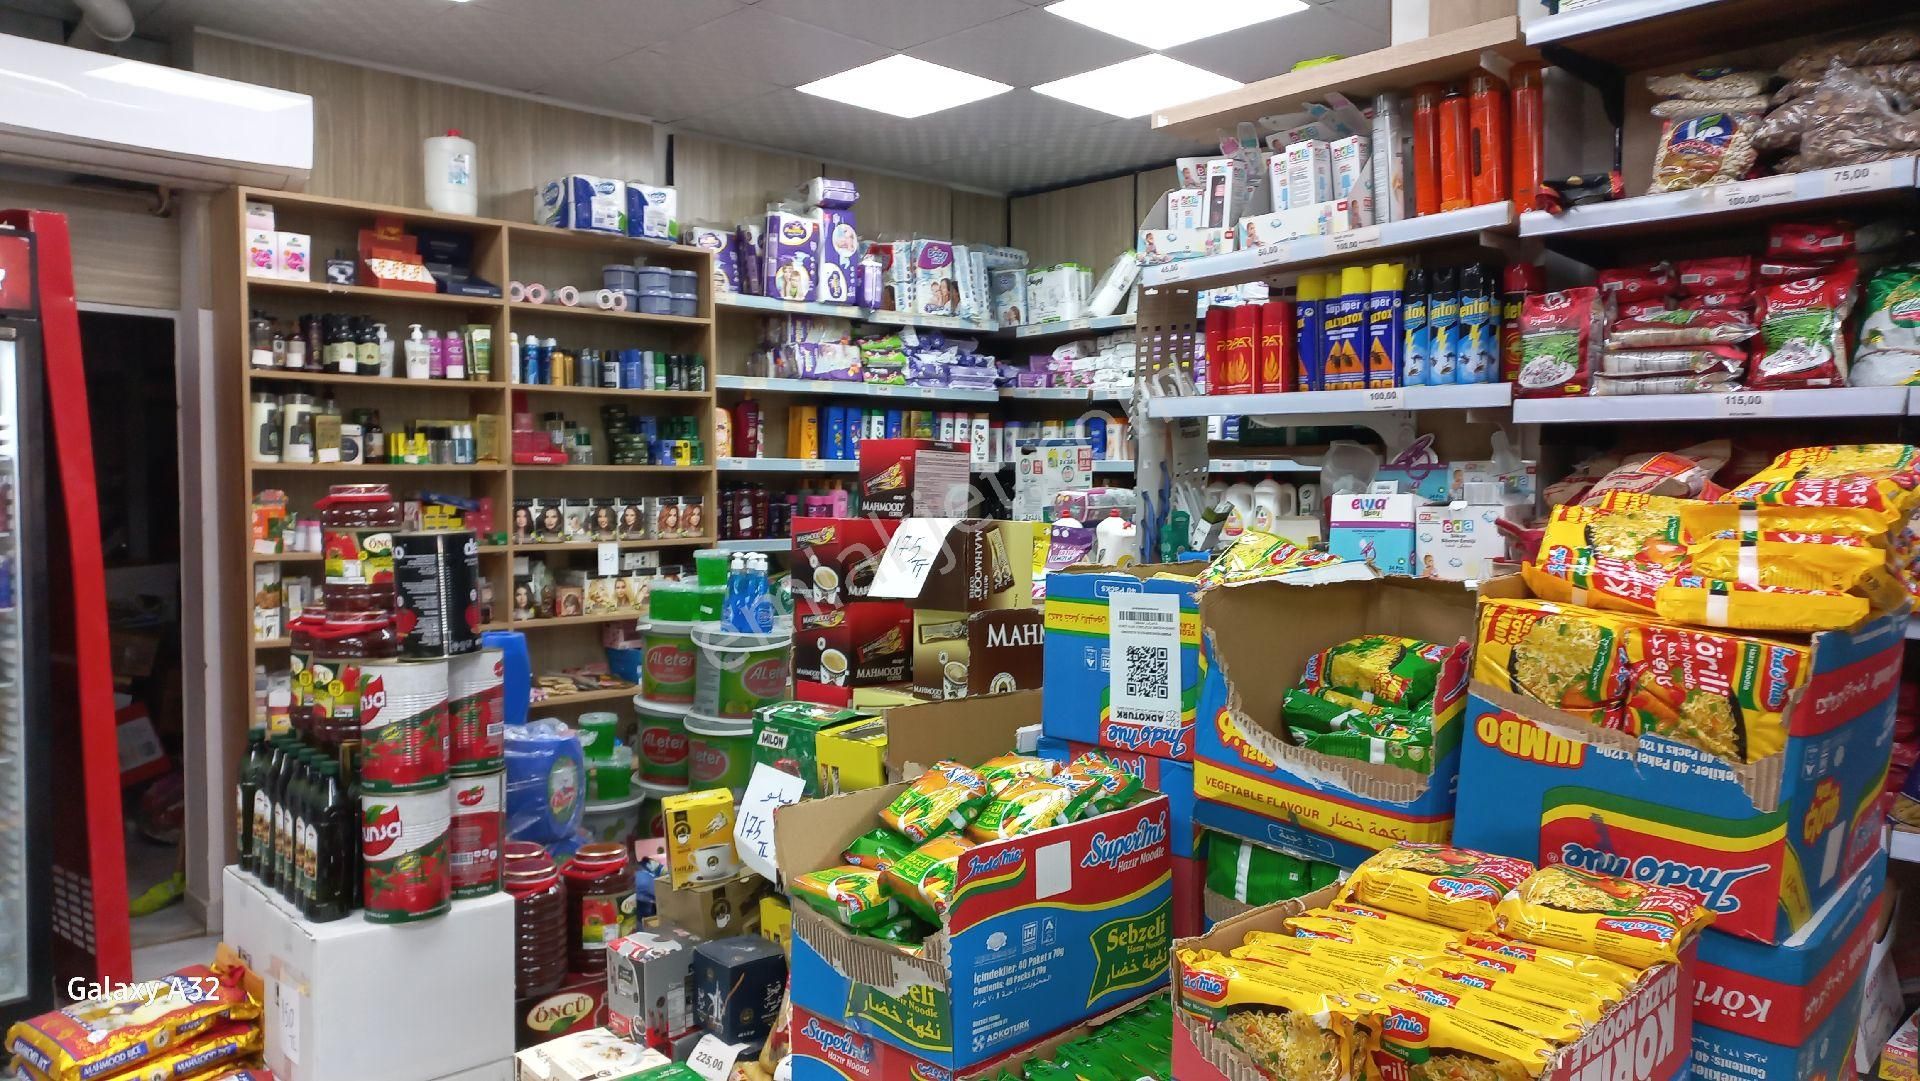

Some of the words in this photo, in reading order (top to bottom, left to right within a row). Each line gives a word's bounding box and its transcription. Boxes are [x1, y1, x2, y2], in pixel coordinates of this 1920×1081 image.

[1833, 167, 1870, 181] 75,00
[1724, 395, 1762, 406] 115,00
[862, 500, 905, 511] MAHMOOD
[1442, 519, 1474, 533] eda
[974, 529, 982, 600] MAHMOOD
[856, 666, 904, 679] MAHMOOD
[1116, 709, 1164, 722] ADKOTURK
[761, 733, 785, 748] MILON
[1637, 751, 1672, 771] Paket
[1673, 760, 1690, 774] 40
[1205, 775, 1265, 803] VEGETABLE
[1266, 796, 1320, 820] FLAVOUR
[740, 811, 766, 841] 175
[1327, 811, 1365, 833] خضار
[1368, 821, 1408, 842] نكهة
[757, 841, 769, 858] TL
[1139, 846, 1165, 866] Noodle
[1106, 913, 1166, 953] Sebzeli
[1018, 959, 1028, 971] 40
[1028, 952, 1048, 969] Paket
[1141, 947, 1168, 972] نكهة
[1105, 963, 1140, 987] خضار
[535, 994, 588, 1024] ÖNCÜ
[863, 992, 903, 1024] خضار
[908, 1003, 939, 1018] Noodle
[906, 1013, 941, 1041] نكهة
[1571, 1000, 1636, 1072] NOODLE
[695, 1050, 723, 1072] 225,00
[846, 1060, 870, 1077] Noodle
